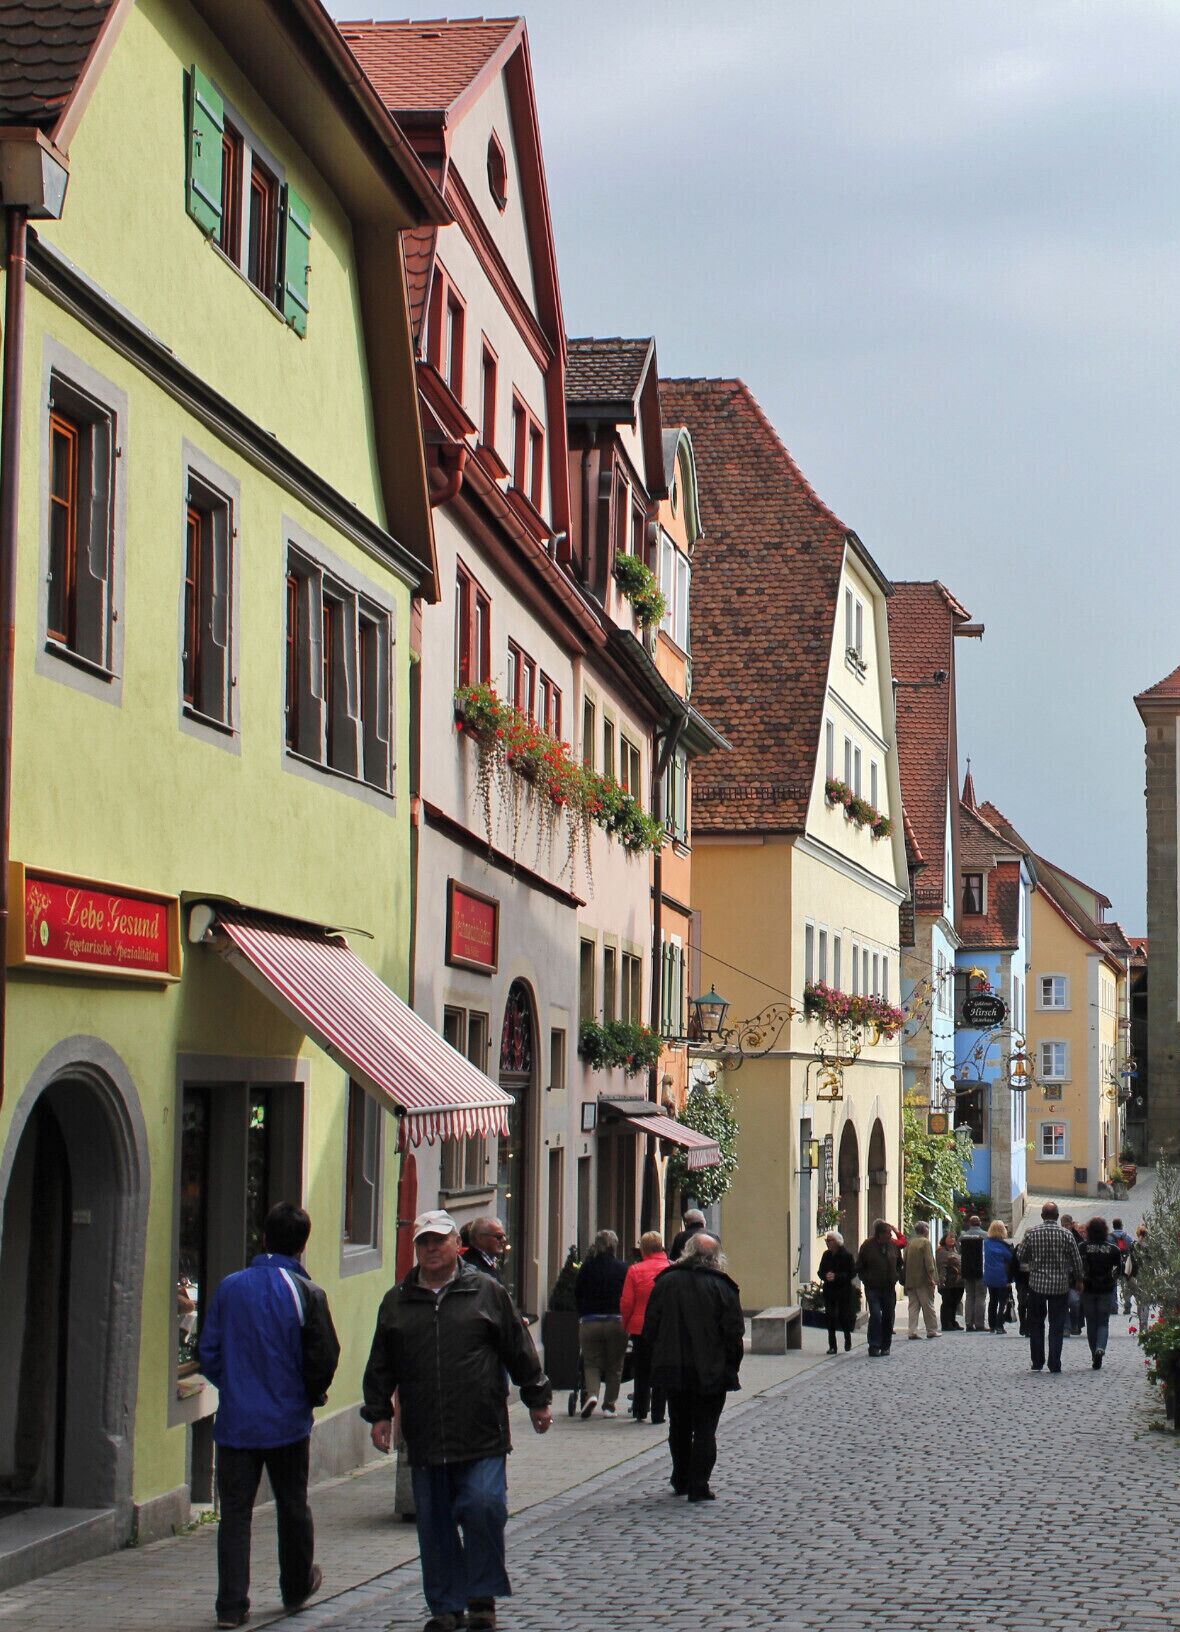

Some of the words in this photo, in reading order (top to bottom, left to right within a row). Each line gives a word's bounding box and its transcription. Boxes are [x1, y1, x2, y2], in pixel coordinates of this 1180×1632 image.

[63, 889, 104, 930] Lebe
[107, 897, 159, 939] Gesund
[64, 931, 112, 957] Vegetarische
[112, 939, 159, 962] Spezialitäten
[970, 1008, 997, 1017] Hirsch
